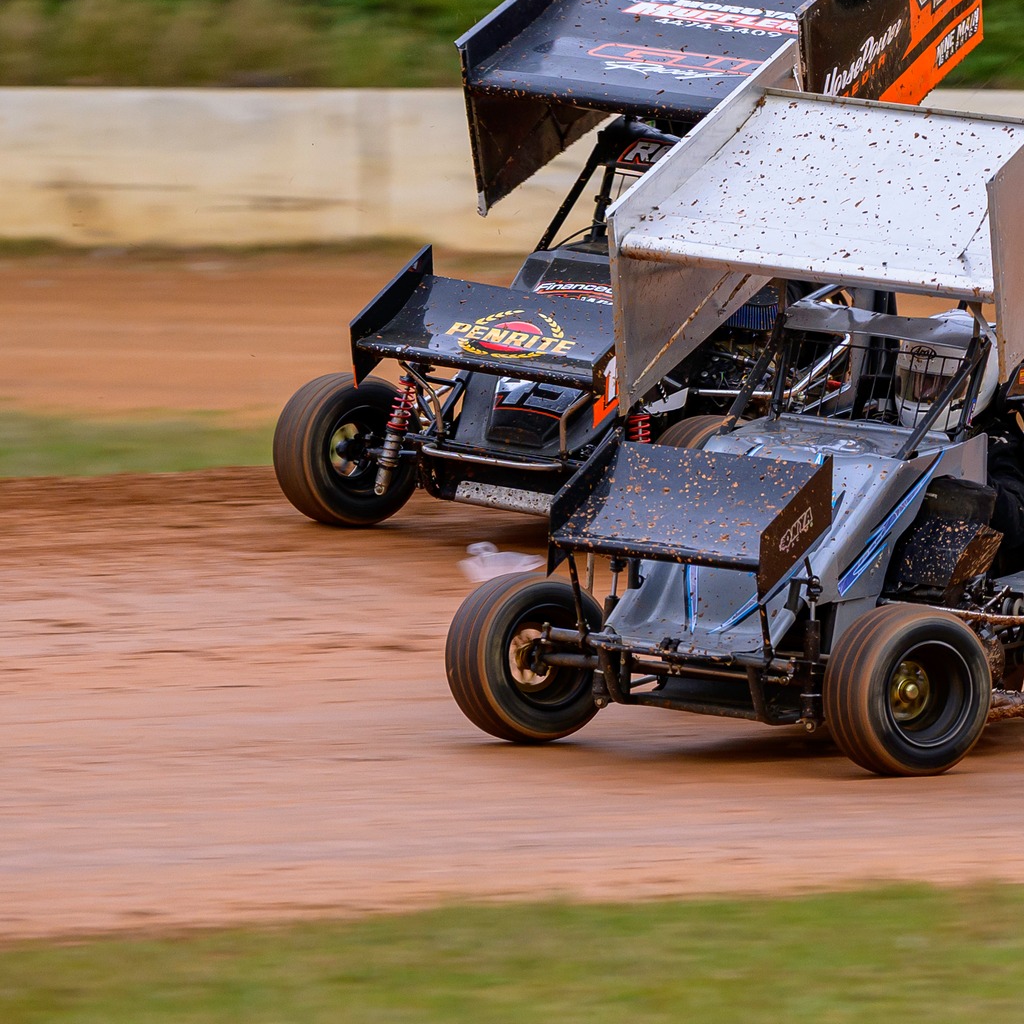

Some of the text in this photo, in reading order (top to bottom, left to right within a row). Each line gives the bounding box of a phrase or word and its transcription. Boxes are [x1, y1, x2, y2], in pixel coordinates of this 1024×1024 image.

[674, 0, 797, 21] MORUYA
[655, 18, 783, 39] 4474 3409
[823, 18, 902, 97] HorsePower
[446, 322, 576, 355] PENRITE
